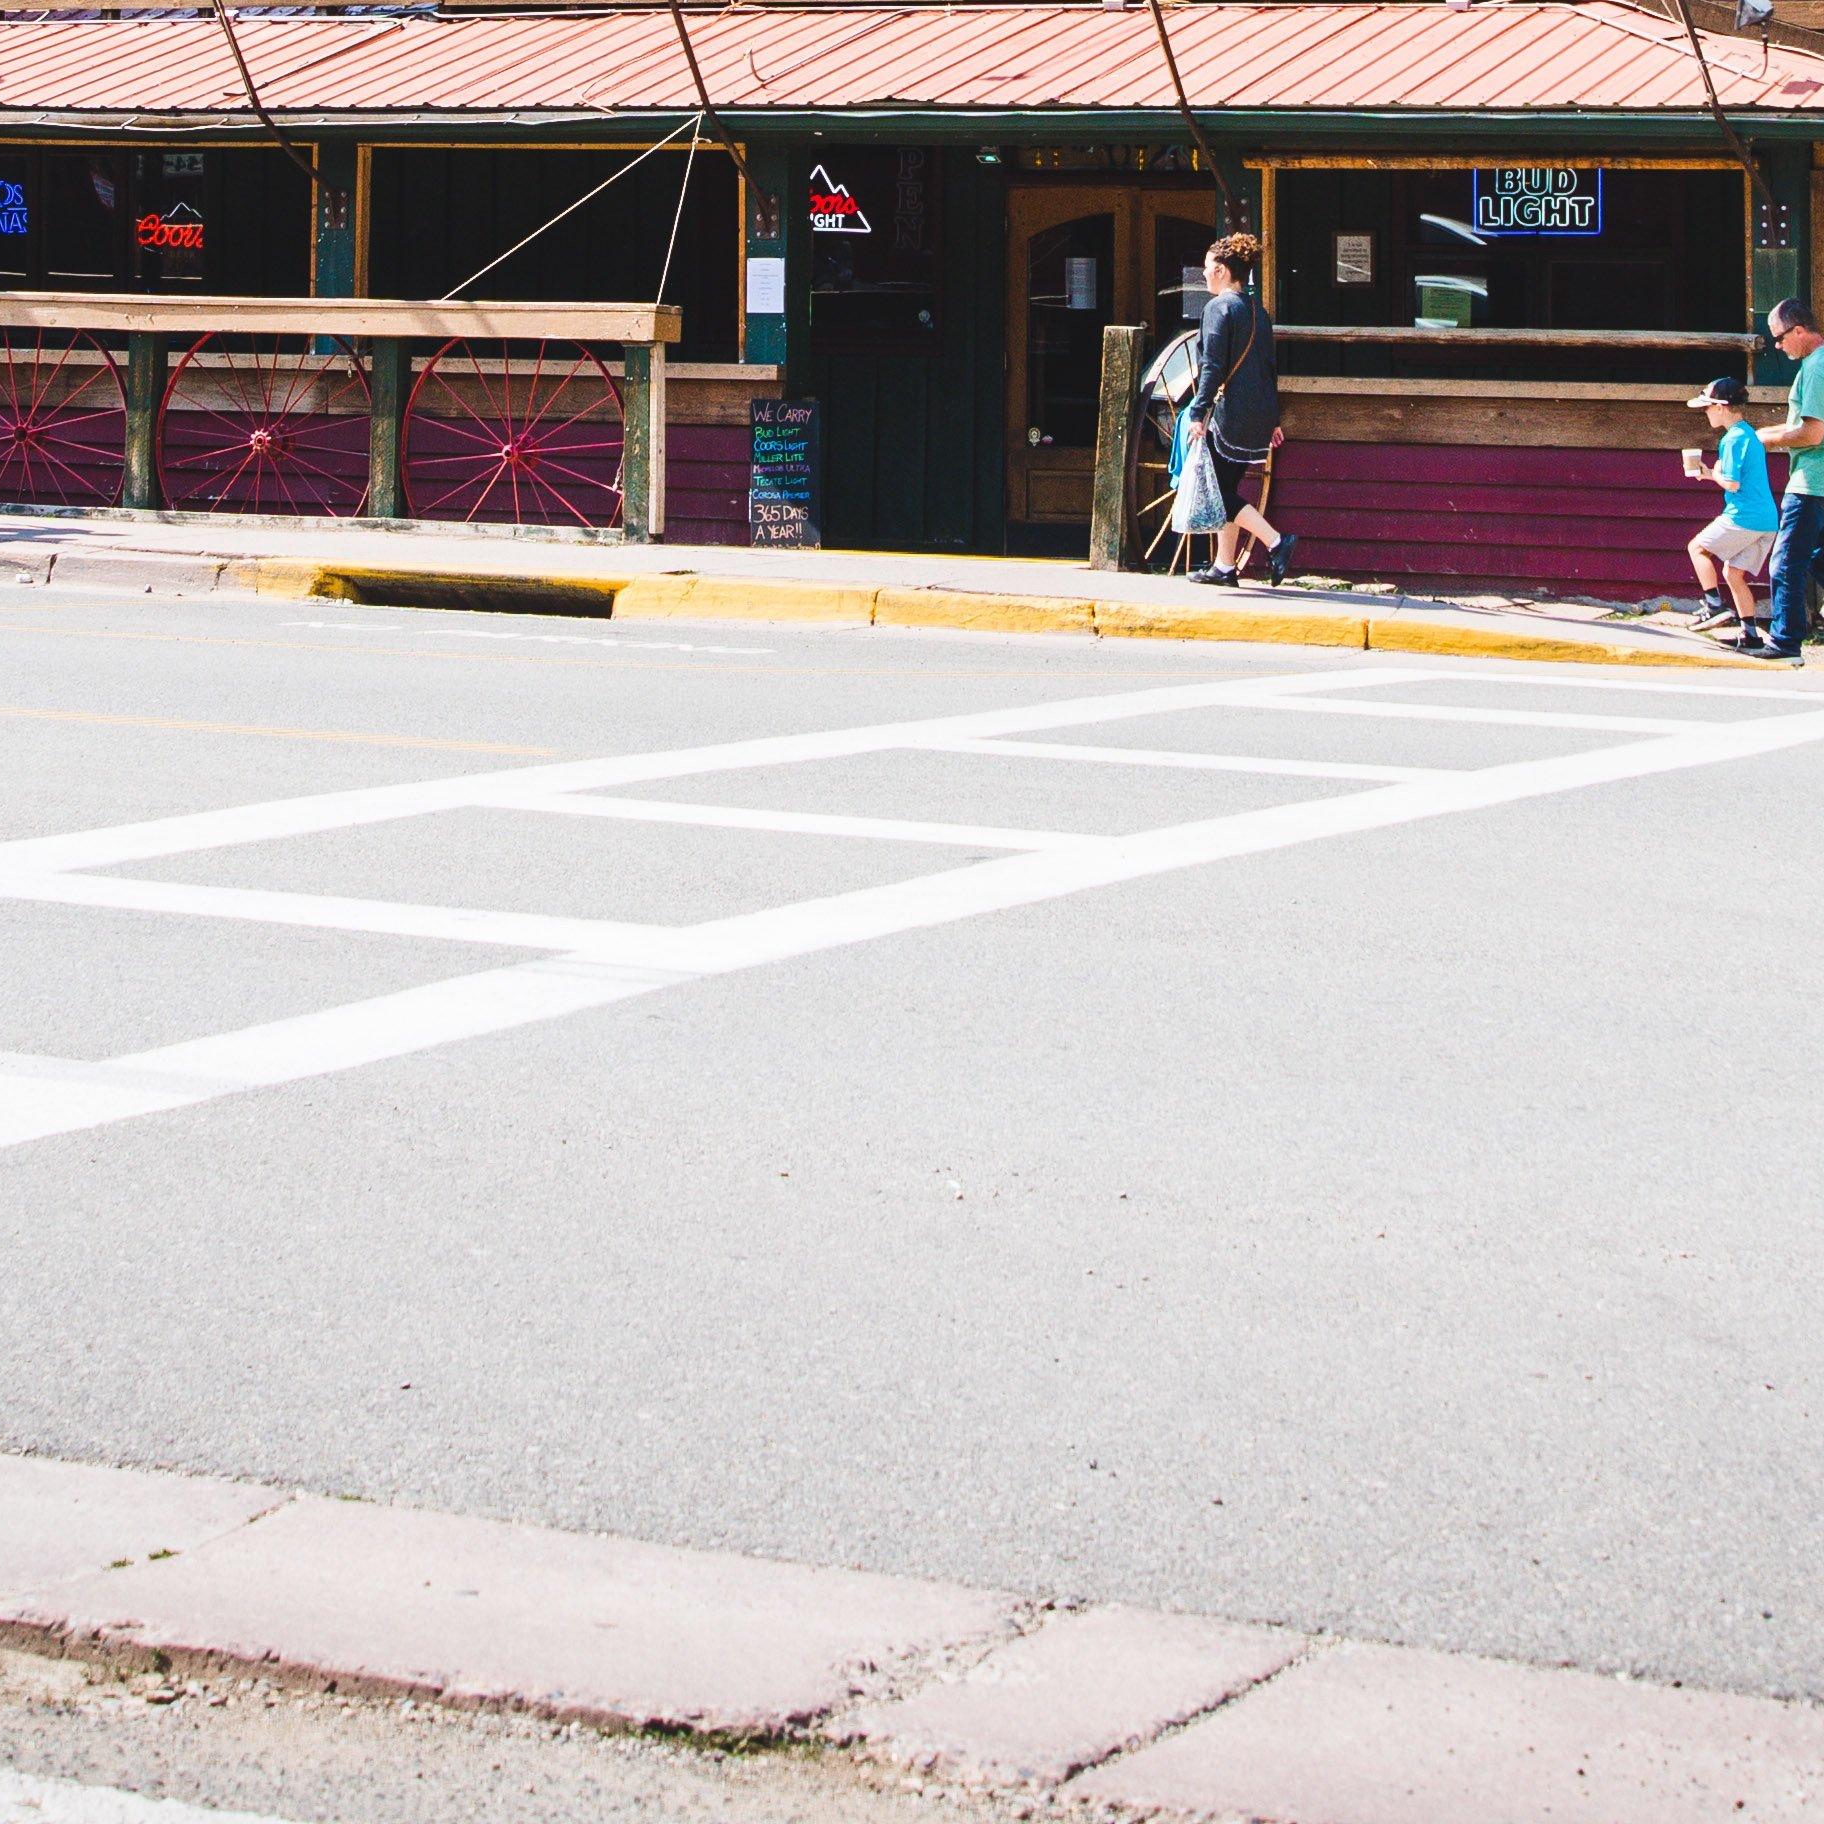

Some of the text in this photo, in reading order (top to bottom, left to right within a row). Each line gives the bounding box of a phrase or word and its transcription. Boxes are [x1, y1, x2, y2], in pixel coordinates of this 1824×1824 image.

[1495, 168, 1577, 196] BUD
[1479, 195, 1595, 227] LIGHT
[752, 402, 813, 425] WE CARRY
[754, 426, 801, 438] BUD LIGHT
[753, 439, 809, 452] COORS LIGHT
[753, 452, 805, 463] MILLER LITE
[753, 503, 809, 524] 365 DAYS
[754, 522, 803, 540] A YEAR!!
